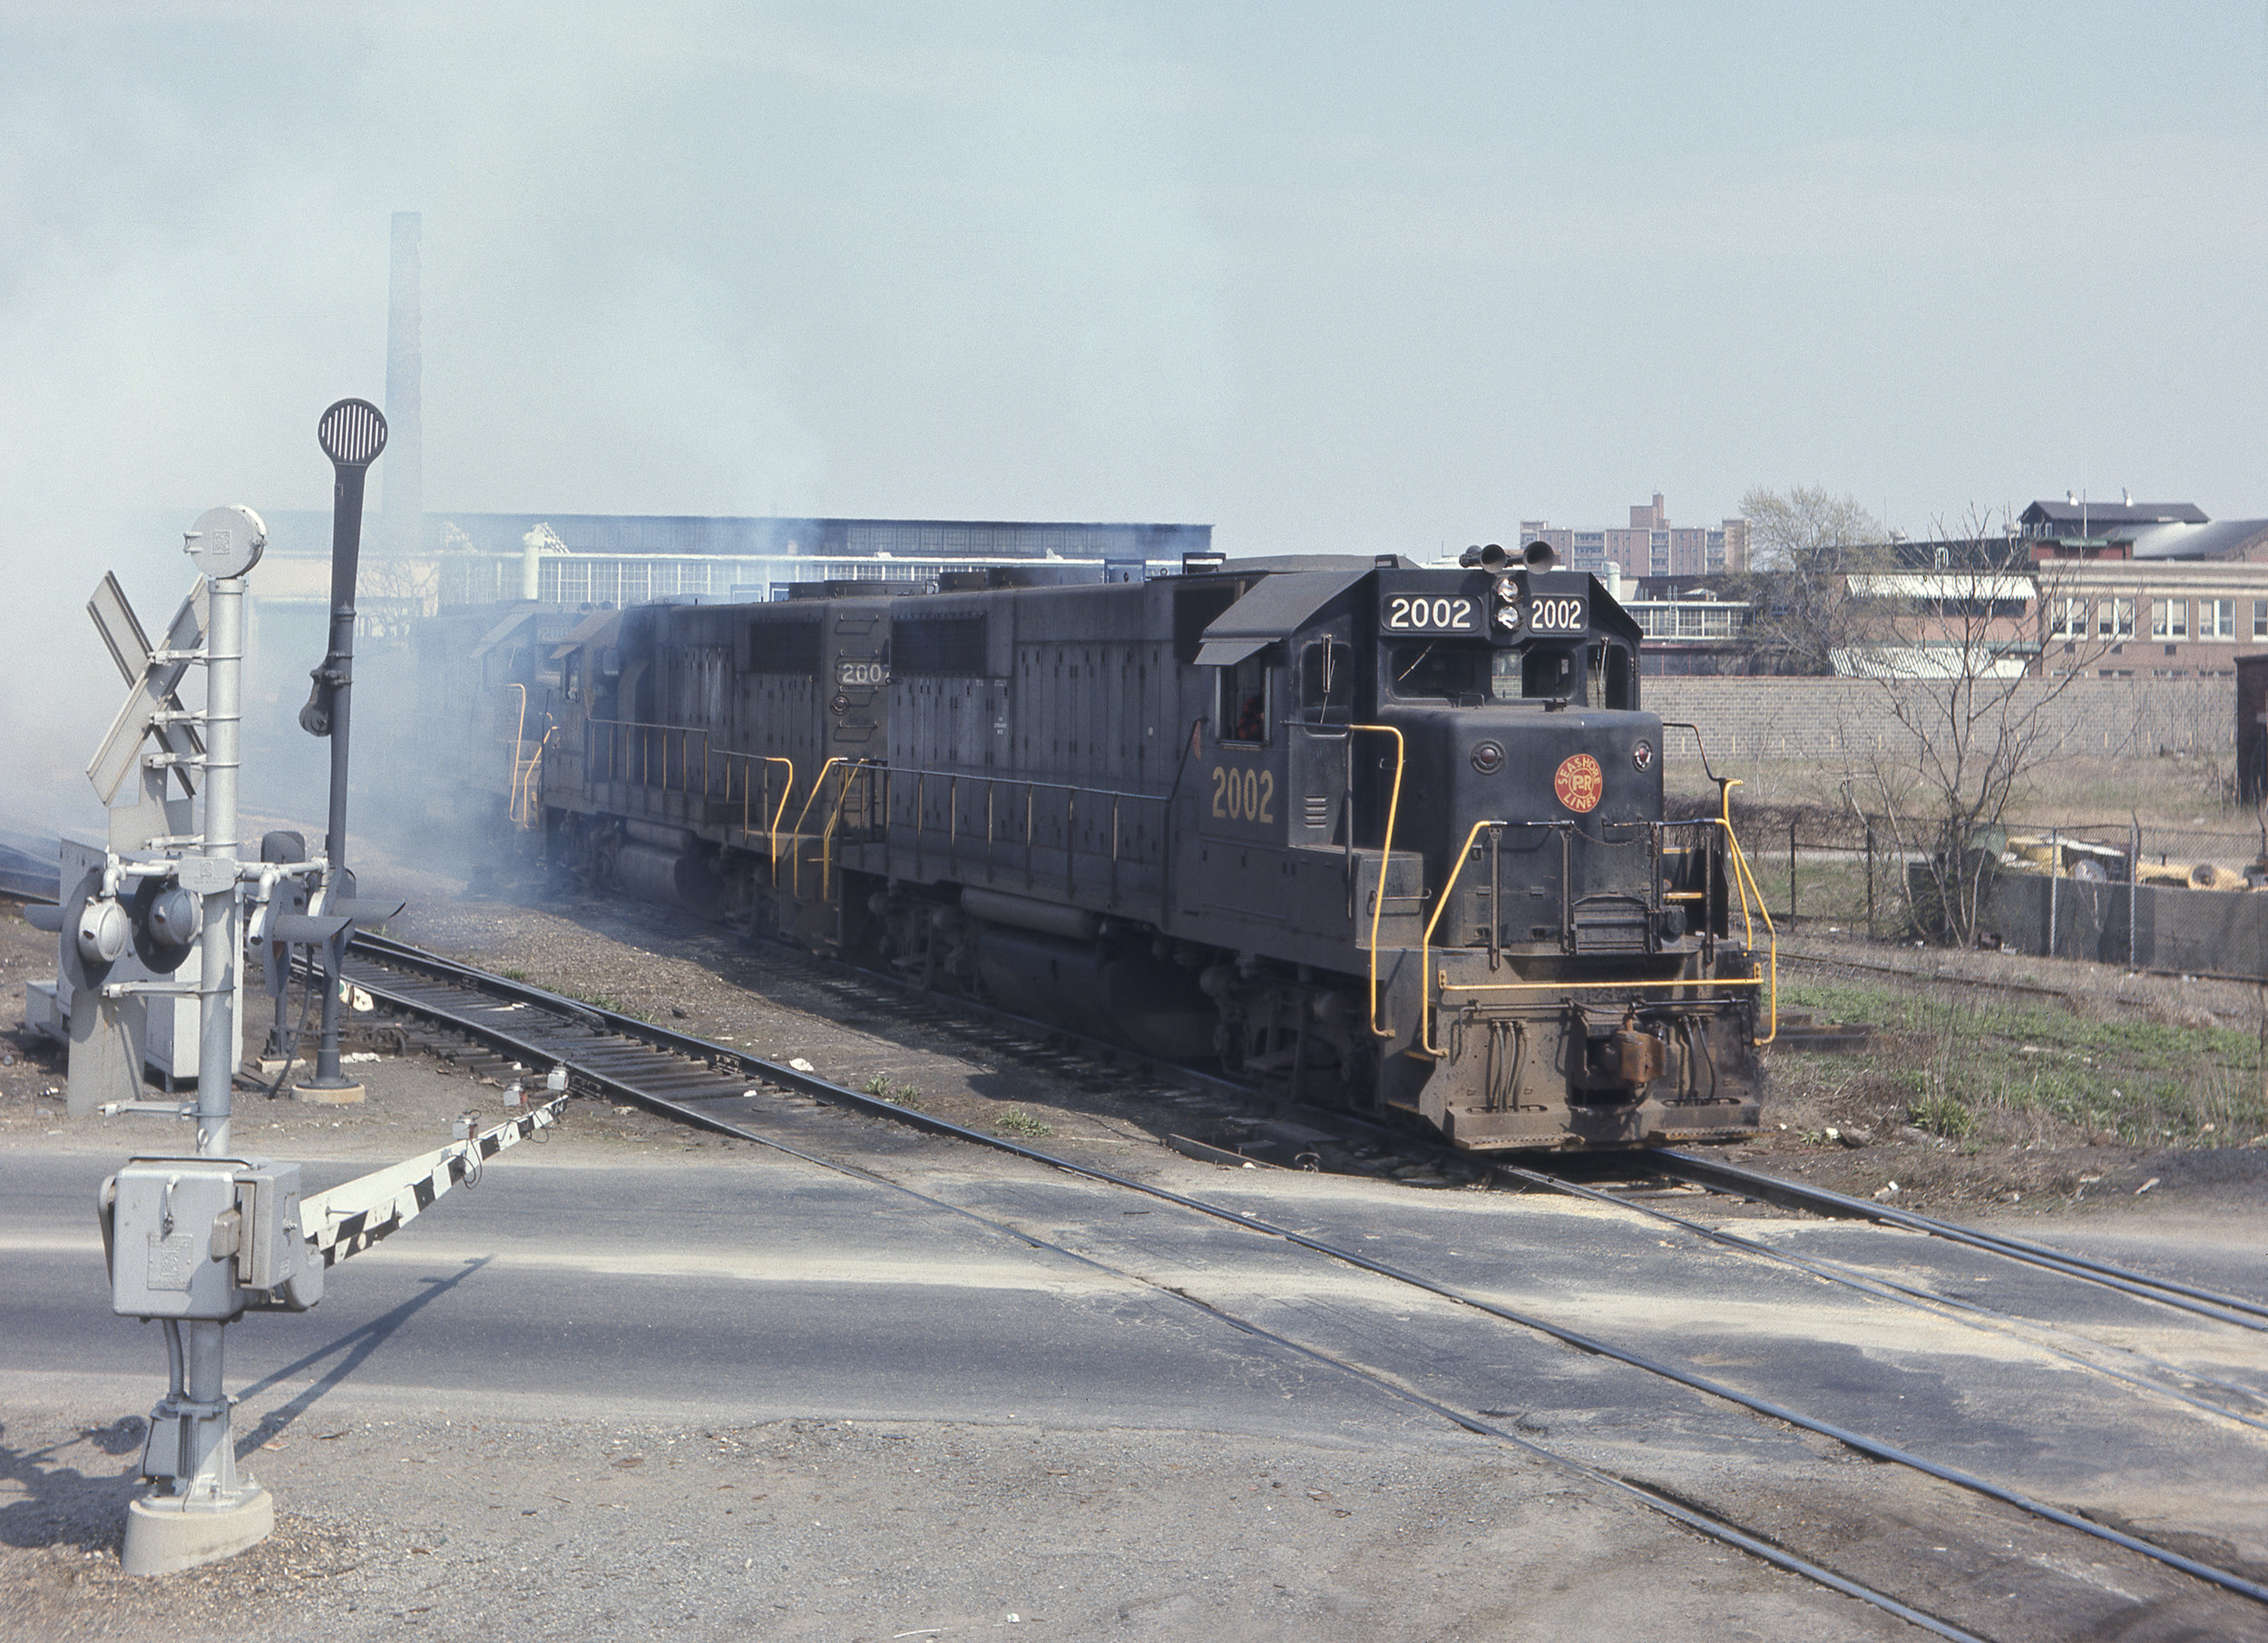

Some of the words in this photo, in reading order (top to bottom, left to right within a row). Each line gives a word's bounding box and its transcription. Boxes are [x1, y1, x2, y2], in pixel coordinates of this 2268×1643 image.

[1391, 598, 1471, 628] 2002
[1531, 600, 1581, 629] 2002
[843, 663, 889, 682] 200
[1558, 757, 1600, 785] SEASHORE
[1212, 766, 1274, 825] 2002
[1563, 792, 1596, 809] LINES
